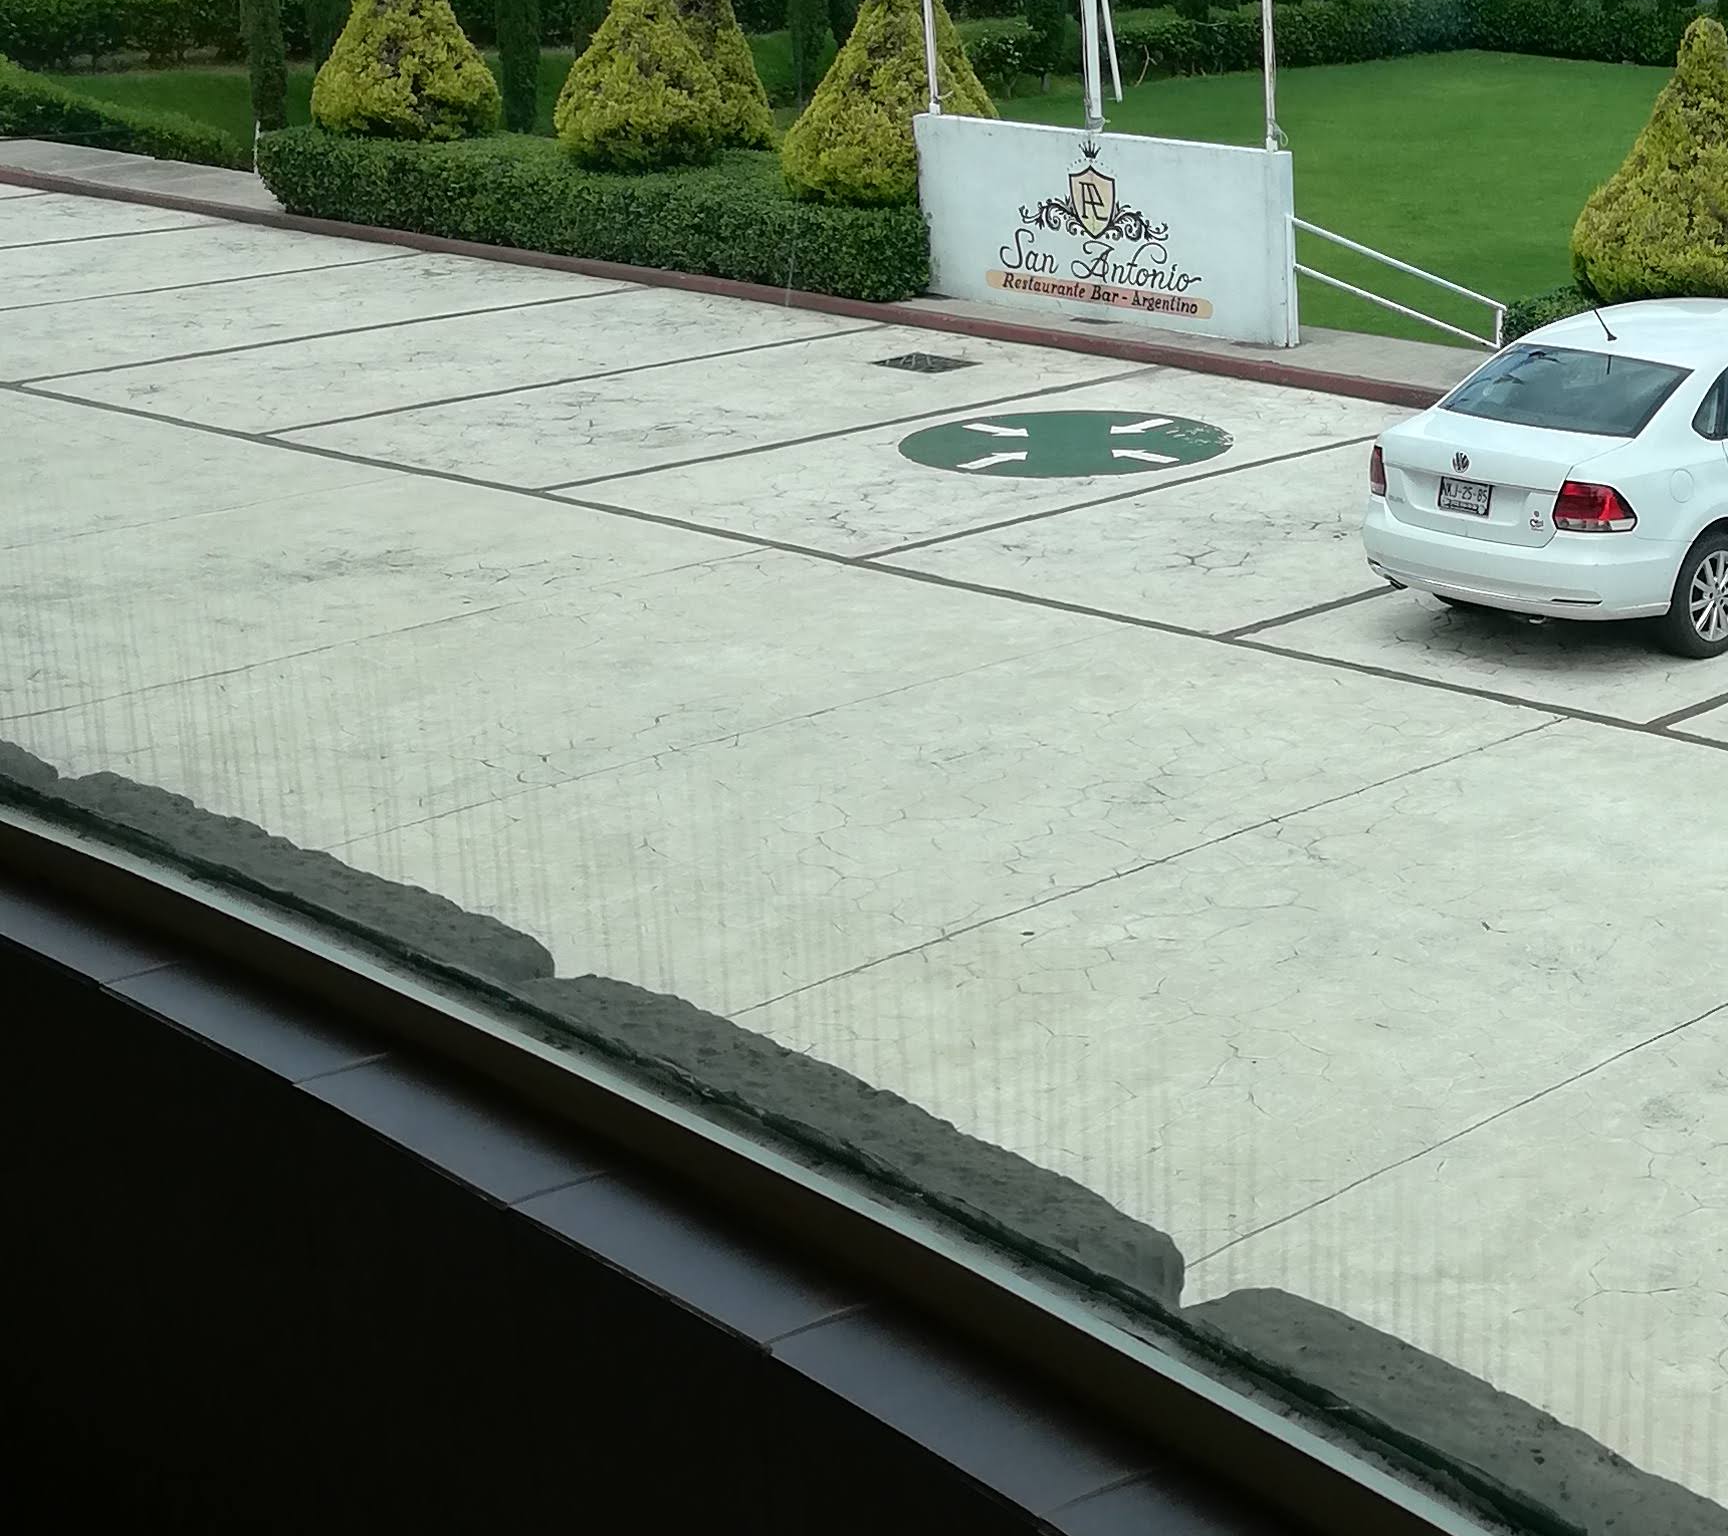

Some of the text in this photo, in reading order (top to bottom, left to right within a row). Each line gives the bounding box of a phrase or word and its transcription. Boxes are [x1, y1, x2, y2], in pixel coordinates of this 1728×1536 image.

[1000, 229, 1202, 292] San Antonio
[1002, 273, 1086, 298] Restaurante
[1090, 285, 1119, 303] Bar
[1131, 291, 1198, 314] Argentino
